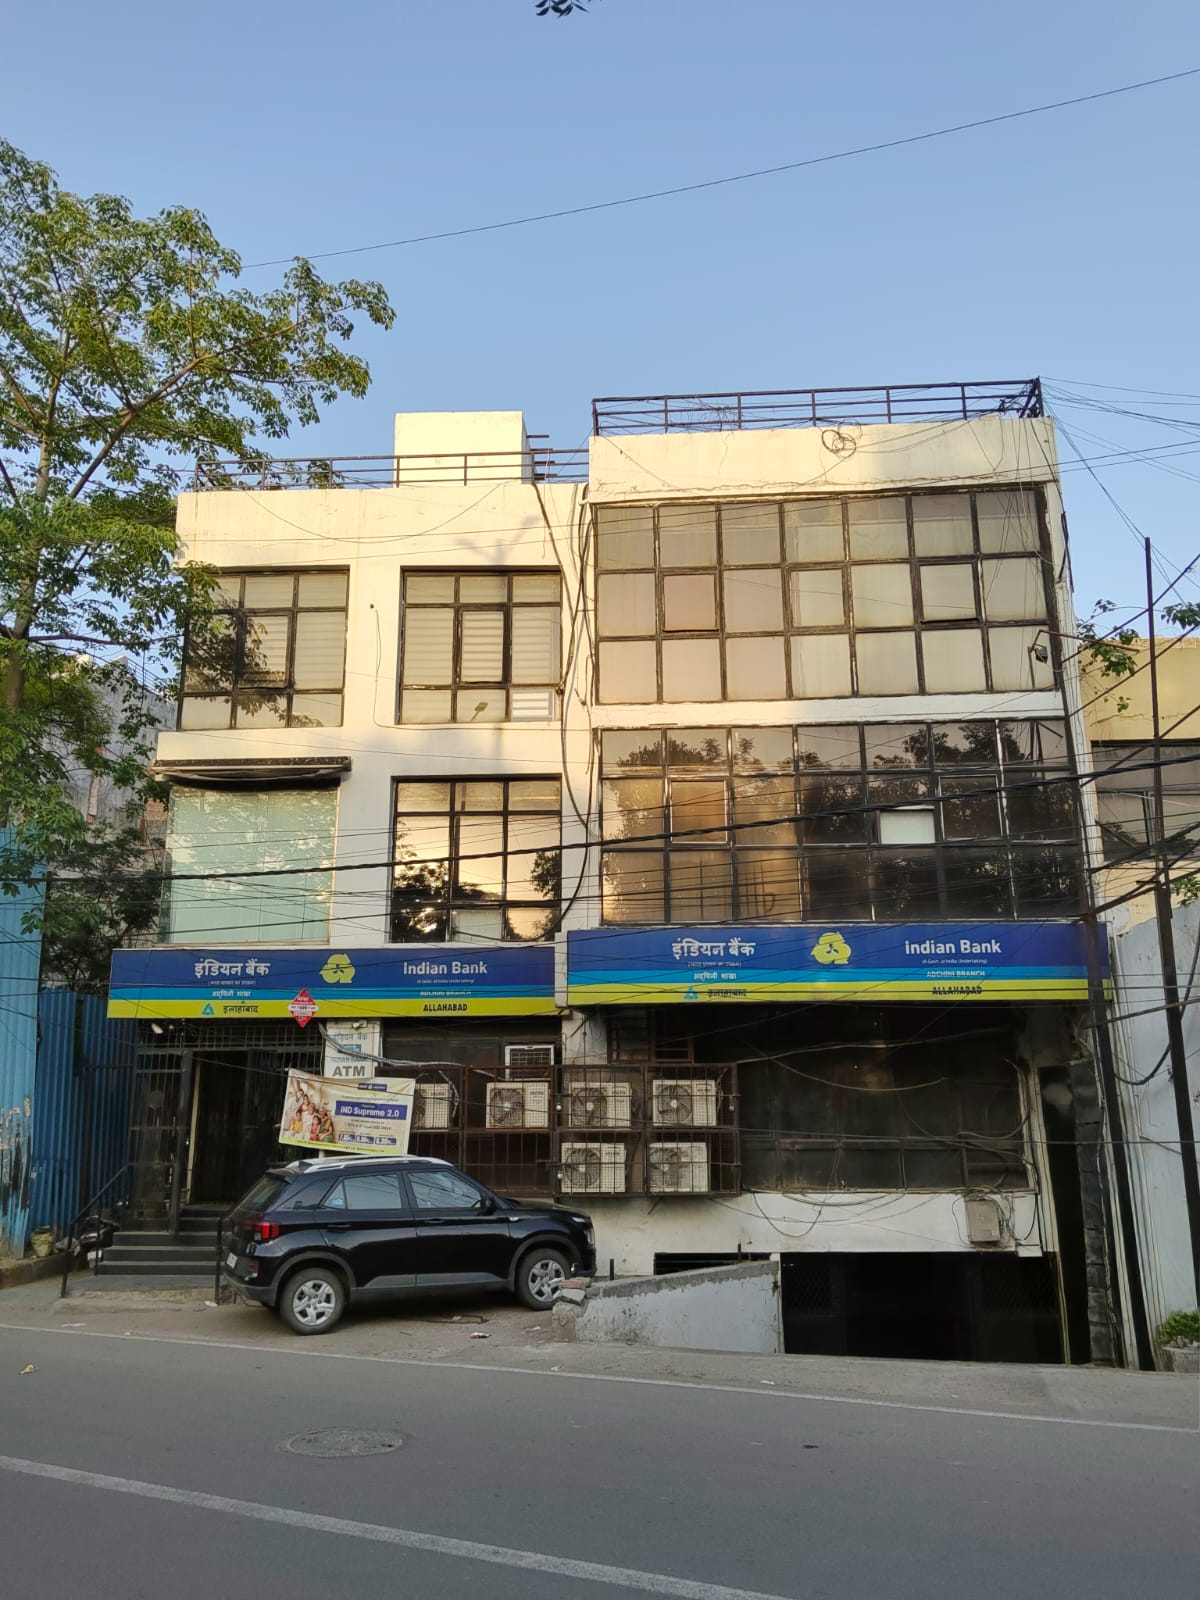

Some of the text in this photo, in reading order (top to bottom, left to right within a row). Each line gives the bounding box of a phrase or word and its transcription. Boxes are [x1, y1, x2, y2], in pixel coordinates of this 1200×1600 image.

[671, 937, 757, 960] इंडियन बैंक
[904, 939, 1002, 955] Indian Bank
[194, 958, 271, 979] इंडियन बैंक
[403, 961, 488, 975] Indian Bank
[223, 1005, 260, 1015] इलाहाबाद
[423, 1003, 468, 1012] ALLAHABAD
[332, 1065, 366, 1077] ATM
[340, 1105, 353, 1114] IND
[353, 1107, 386, 1117] Supreme
[387, 1110, 400, 1118] 2.0
